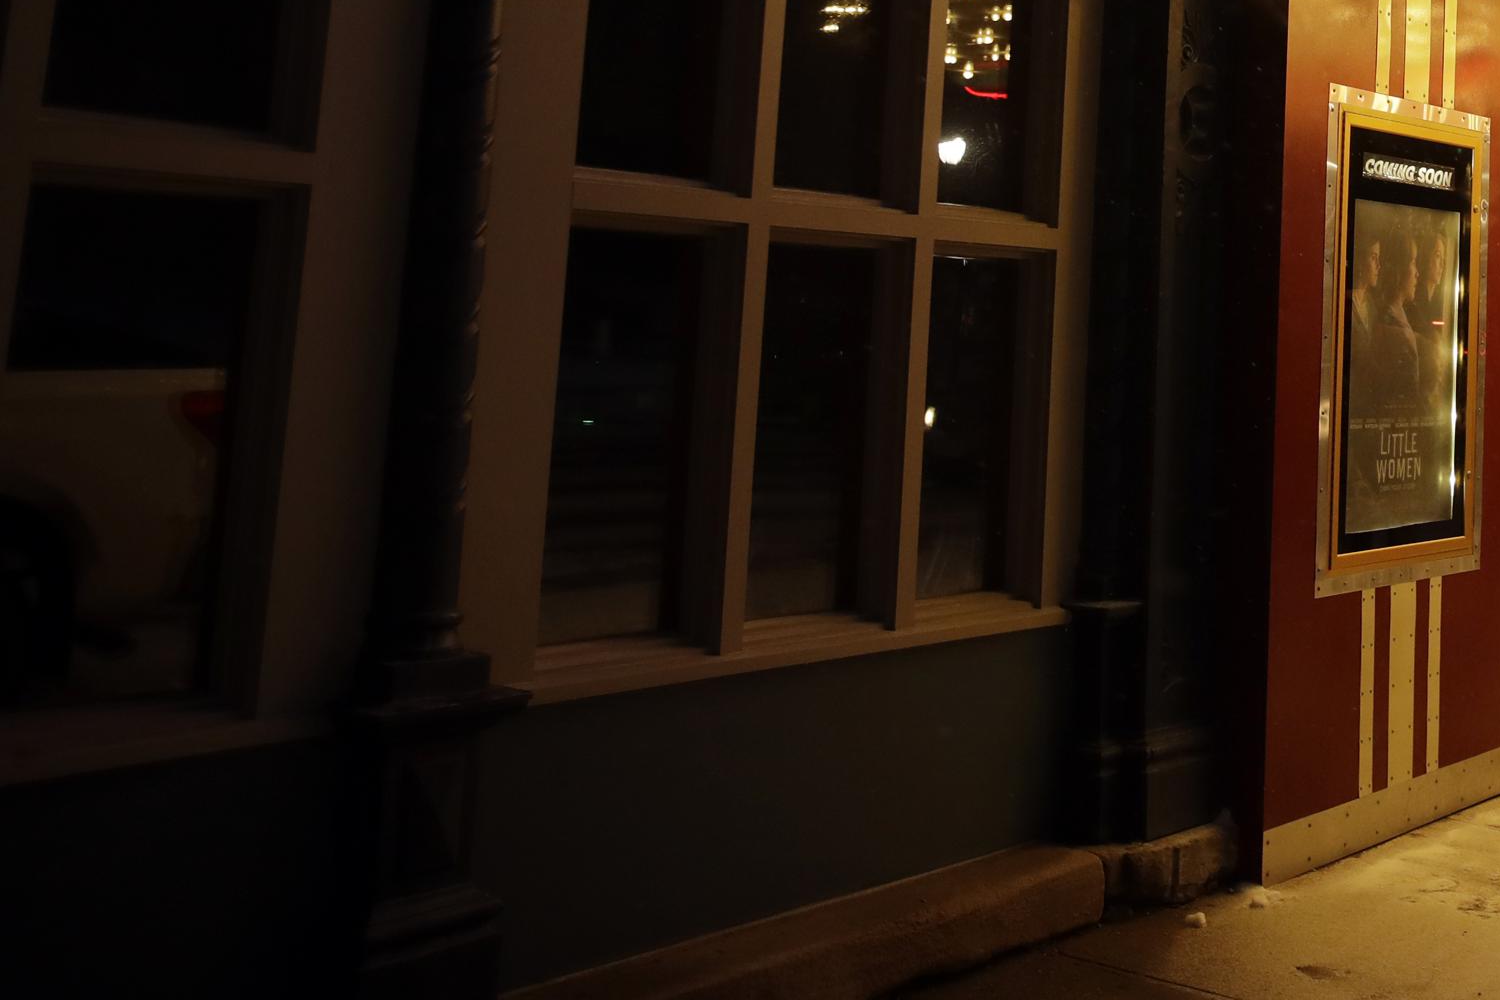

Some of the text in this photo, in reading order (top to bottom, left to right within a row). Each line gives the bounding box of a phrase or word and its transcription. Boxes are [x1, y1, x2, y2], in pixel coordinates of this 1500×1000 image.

[1365, 158, 1453, 187] COMING SOON
[1380, 430, 1417, 457] LITTLE
[1376, 456, 1421, 484] WOMEN
